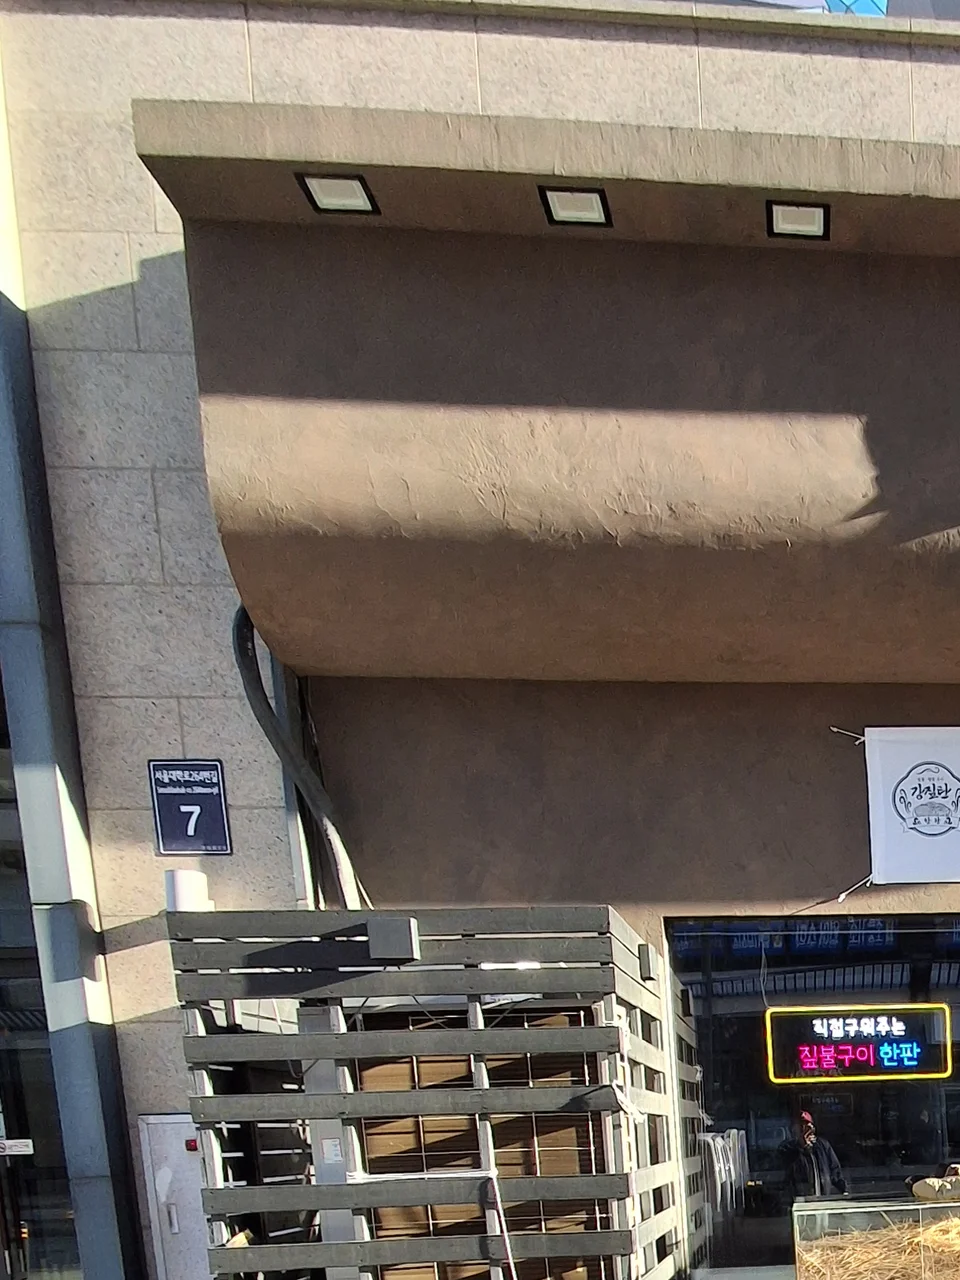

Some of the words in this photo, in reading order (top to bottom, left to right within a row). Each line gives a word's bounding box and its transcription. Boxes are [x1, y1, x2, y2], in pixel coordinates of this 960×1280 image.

[910, 782, 952, 801] 강짚탄
[179, 805, 202, 836] 7
[812, 1016, 907, 1038] 직접구워주는
[798, 1043, 875, 1069] 짚불구이
[879, 1041, 921, 1067] 한판
